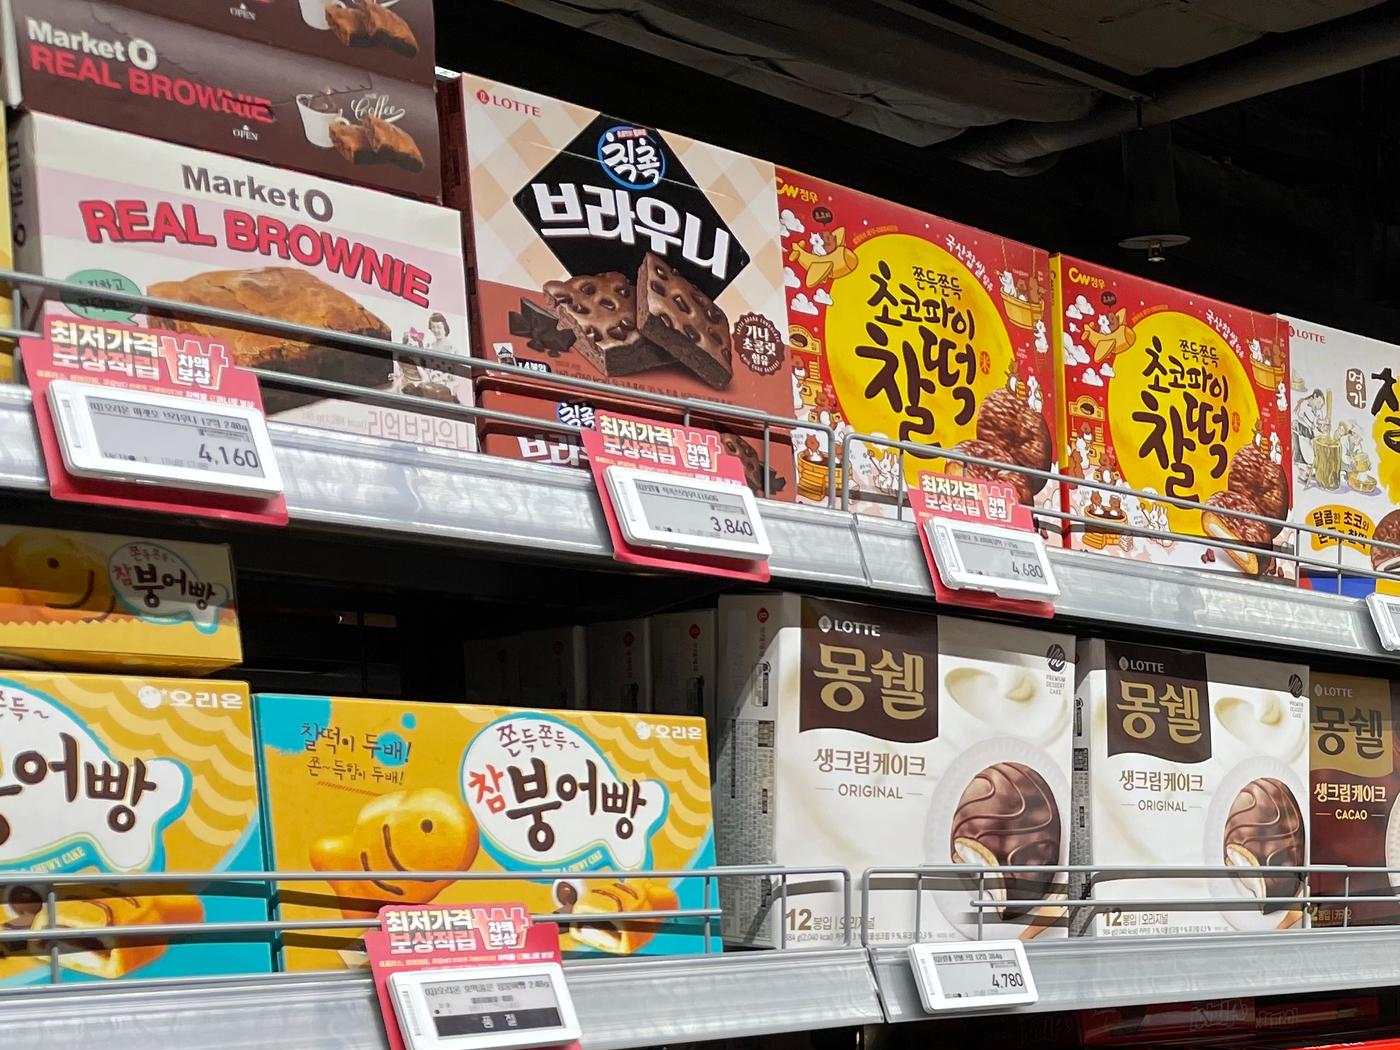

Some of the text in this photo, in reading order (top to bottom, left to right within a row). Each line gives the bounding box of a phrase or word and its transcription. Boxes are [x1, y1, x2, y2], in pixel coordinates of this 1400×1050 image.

[27, 18, 128, 63] Market
[29, 45, 275, 124] REAL BROWNIE
[493, 96, 541, 117] LOTTE
[232, 128, 259, 141] OPEN
[181, 164, 300, 211] Market
[531, 182, 731, 281] 브라우니
[79, 200, 432, 308] REAL BROWNIE
[912, 266, 963, 299] 쫀득쫀득
[867, 260, 976, 341] 초코파이
[50, 320, 159, 358] 최저가격
[1296, 329, 1326, 345] LOTTE
[51, 347, 161, 381] 보상적립
[177, 354, 210, 372] 차액
[177, 369, 211, 386] 보상
[1142, 335, 1229, 403] 초코파이
[855, 321, 977, 460] 찰떡
[600, 415, 674, 449] 최저가격
[603, 437, 677, 467] 보상적립
[1131, 390, 1229, 510] 찰떡
[921, 474, 980, 500] 최저가격
[1312, 511, 1370, 531] 달콤한 초코와
[834, 619, 881, 638] LOTTE
[1131, 659, 1165, 674] LOTTE
[813, 642, 928, 721] 몽쉘
[1324, 687, 1353, 698] LOTTE
[169, 689, 242, 710] 오리온
[1116, 680, 1203, 745] 몽쉘
[300, 721, 356, 753] 찰떡이
[655, 724, 703, 741] 오리온
[1313, 705, 1385, 760] 몽쉘
[813, 748, 927, 777] 생크림케이크
[838, 784, 904, 799] ORIGINAL
[1119, 770, 1204, 793] 생크림케이크
[1314, 782, 1387, 803] 생크림케이크
[505, 756, 647, 853] 붕어빵
[1138, 799, 1188, 813] ORIGINAL
[1335, 808, 1368, 821] CACAO
[385, 908, 474, 933] 최저가격
[390, 929, 477, 953] 보상적립
